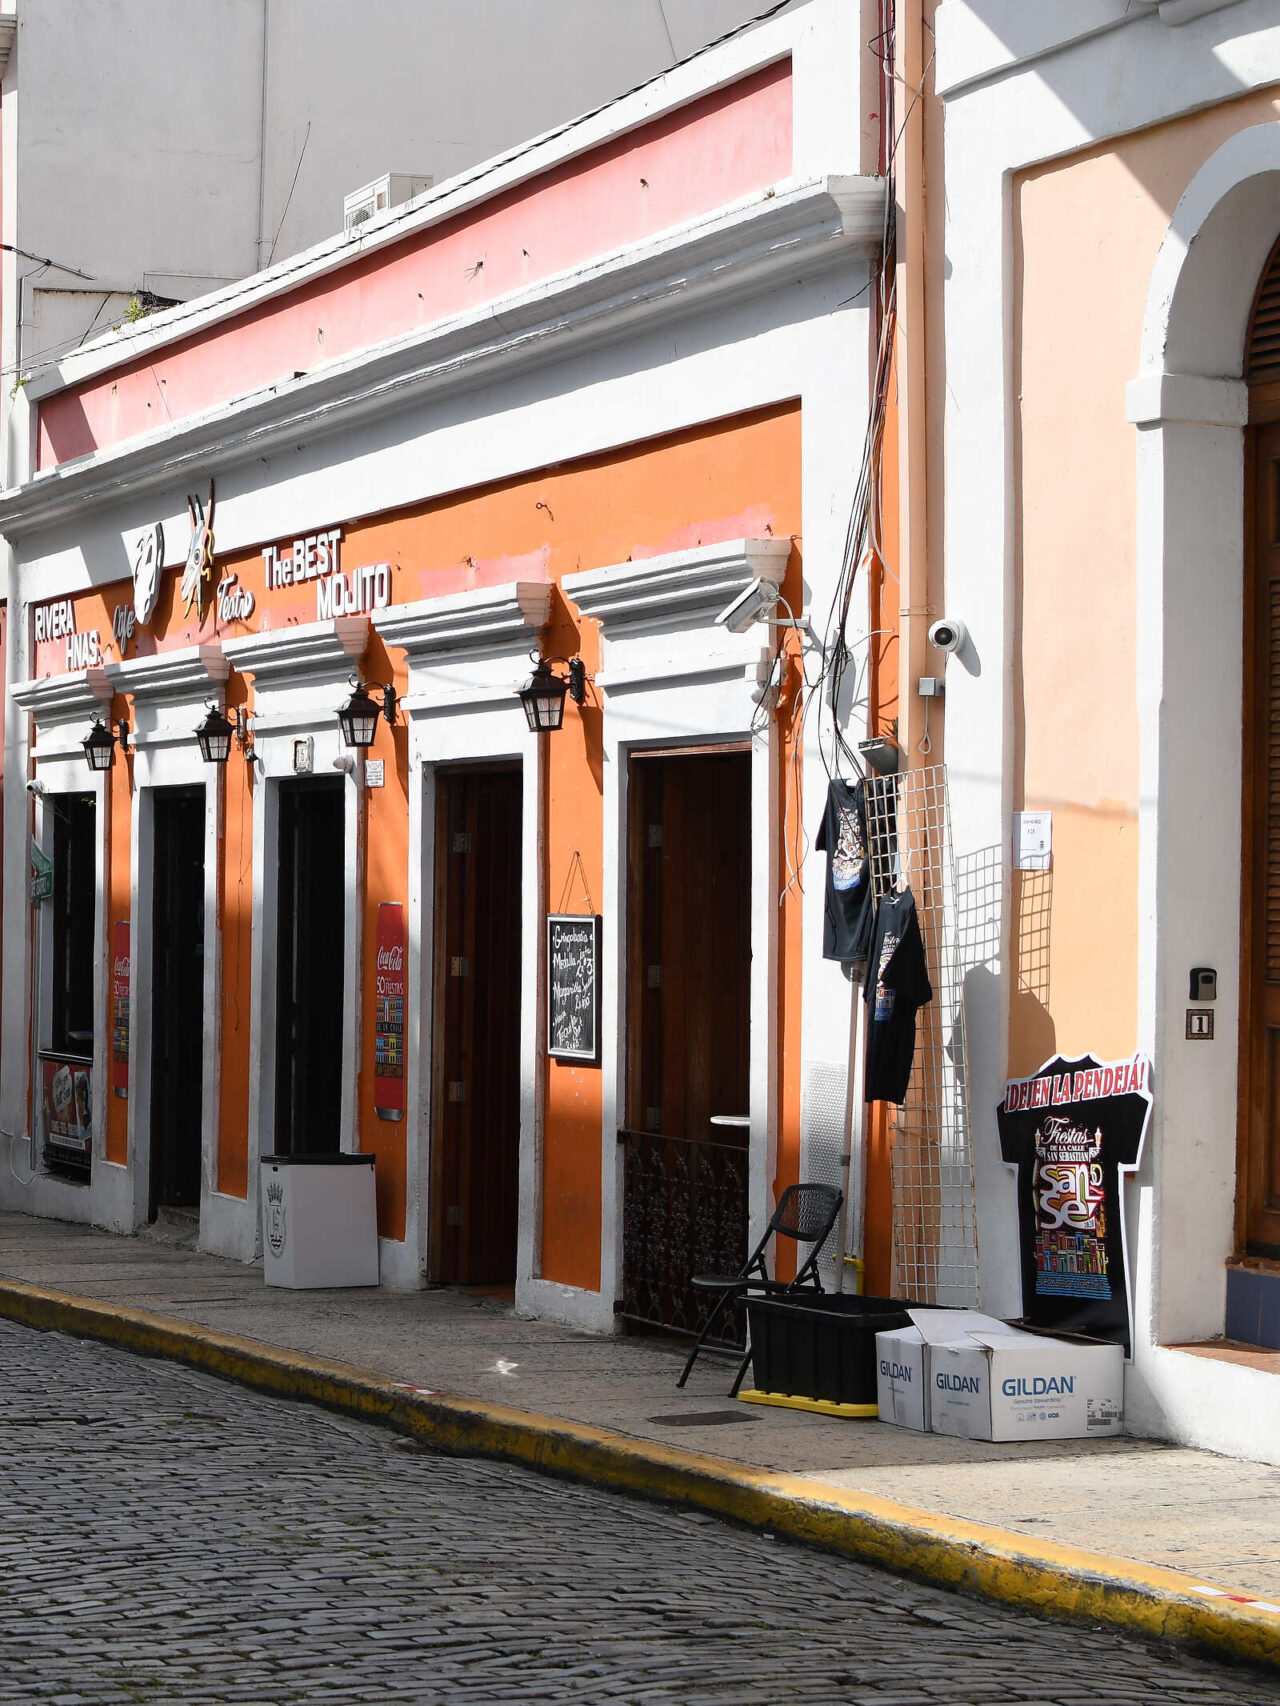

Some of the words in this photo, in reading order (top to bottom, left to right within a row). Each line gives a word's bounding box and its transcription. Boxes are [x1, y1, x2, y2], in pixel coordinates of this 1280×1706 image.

[261, 545, 292, 589] The
[293, 528, 341, 583] BEST
[217, 573, 255, 622] Teatro
[316, 563, 391, 621] MOJITO
[35, 599, 75, 642] RIVERA
[376, 977, 385, 994] 50
[385, 980, 404, 995] FIESTAS
[1196, 1016, 1204, 1033] 1
[1004, 1077, 1050, 1112] ¡DEJEN
[1052, 1074, 1071, 1104] LA
[1072, 1054, 1146, 1101] PENDEJÁ!
[1040, 1116, 1094, 1145] Fiestas
[1047, 1151, 1058, 1161] SAN
[1049, 1144, 1058, 1152] DE
[1059, 1144, 1067, 1152] LA
[1067, 1144, 1085, 1152] CALLE
[880, 1359, 912, 1383] GILDAN
[936, 1372, 979, 1394] GILDAN
[1001, 1375, 1074, 1397] GILDAN
